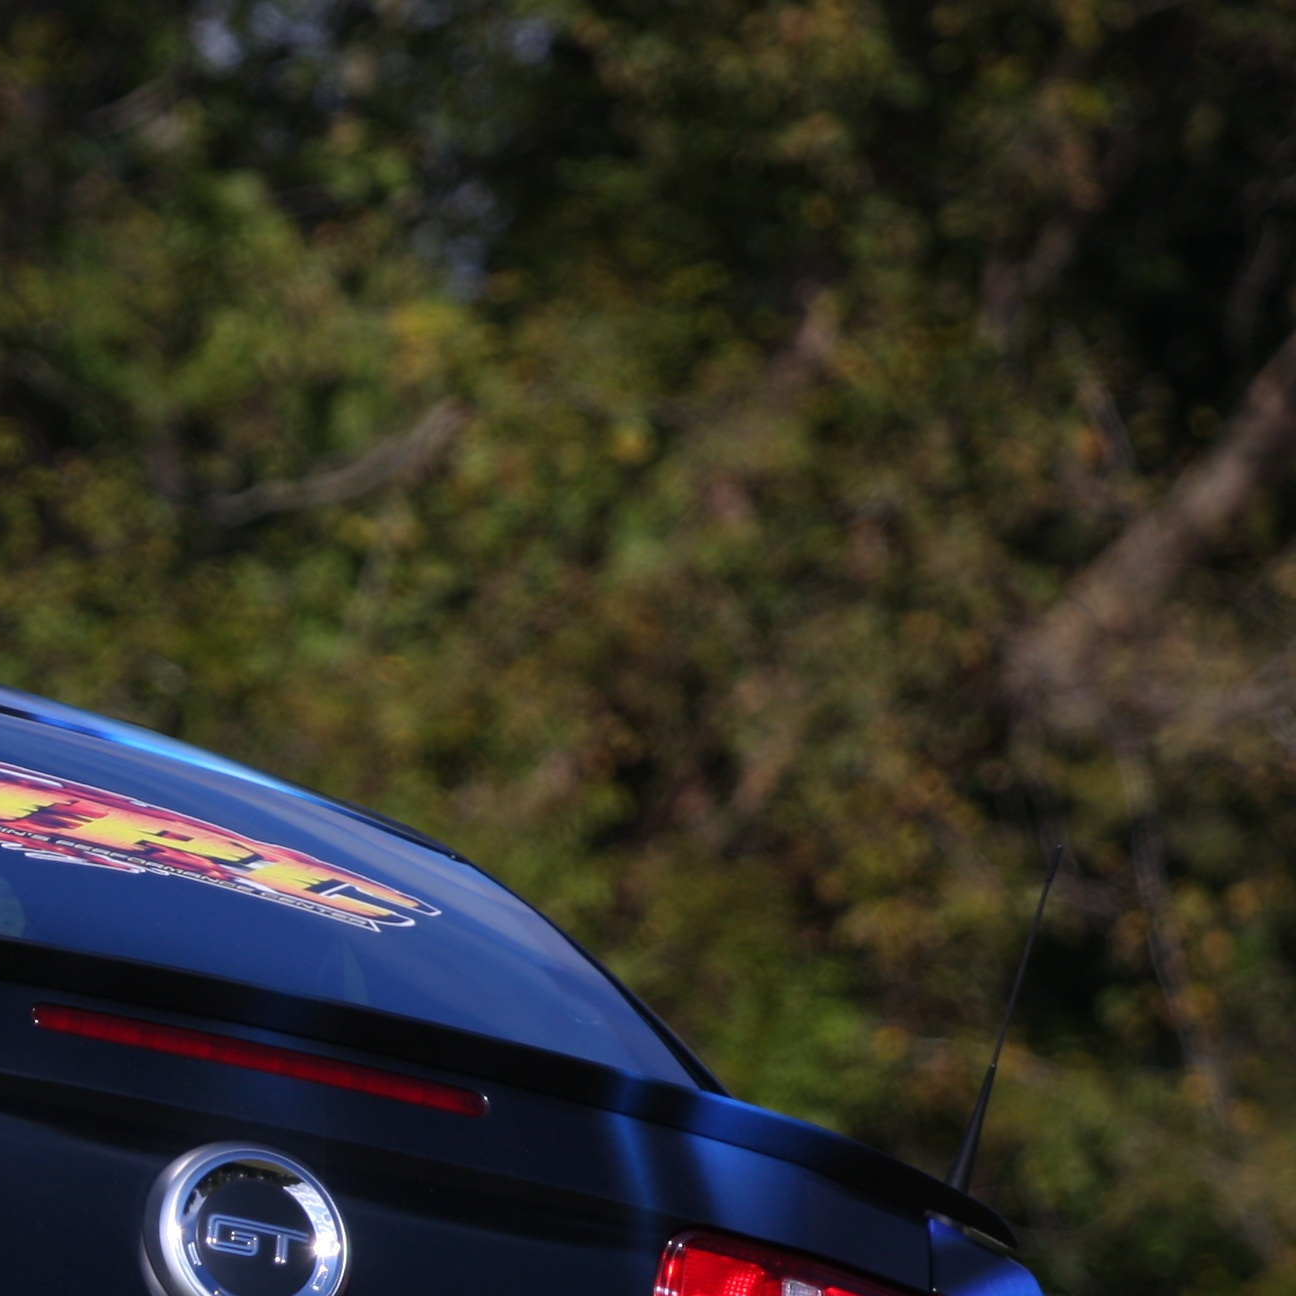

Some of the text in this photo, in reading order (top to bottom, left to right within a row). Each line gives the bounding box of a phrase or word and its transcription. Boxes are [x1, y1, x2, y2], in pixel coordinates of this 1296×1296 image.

[55, 838, 256, 893] PERFORMANCE
[260, 891, 370, 926] CENTER
[206, 1212, 311, 1264] GT
